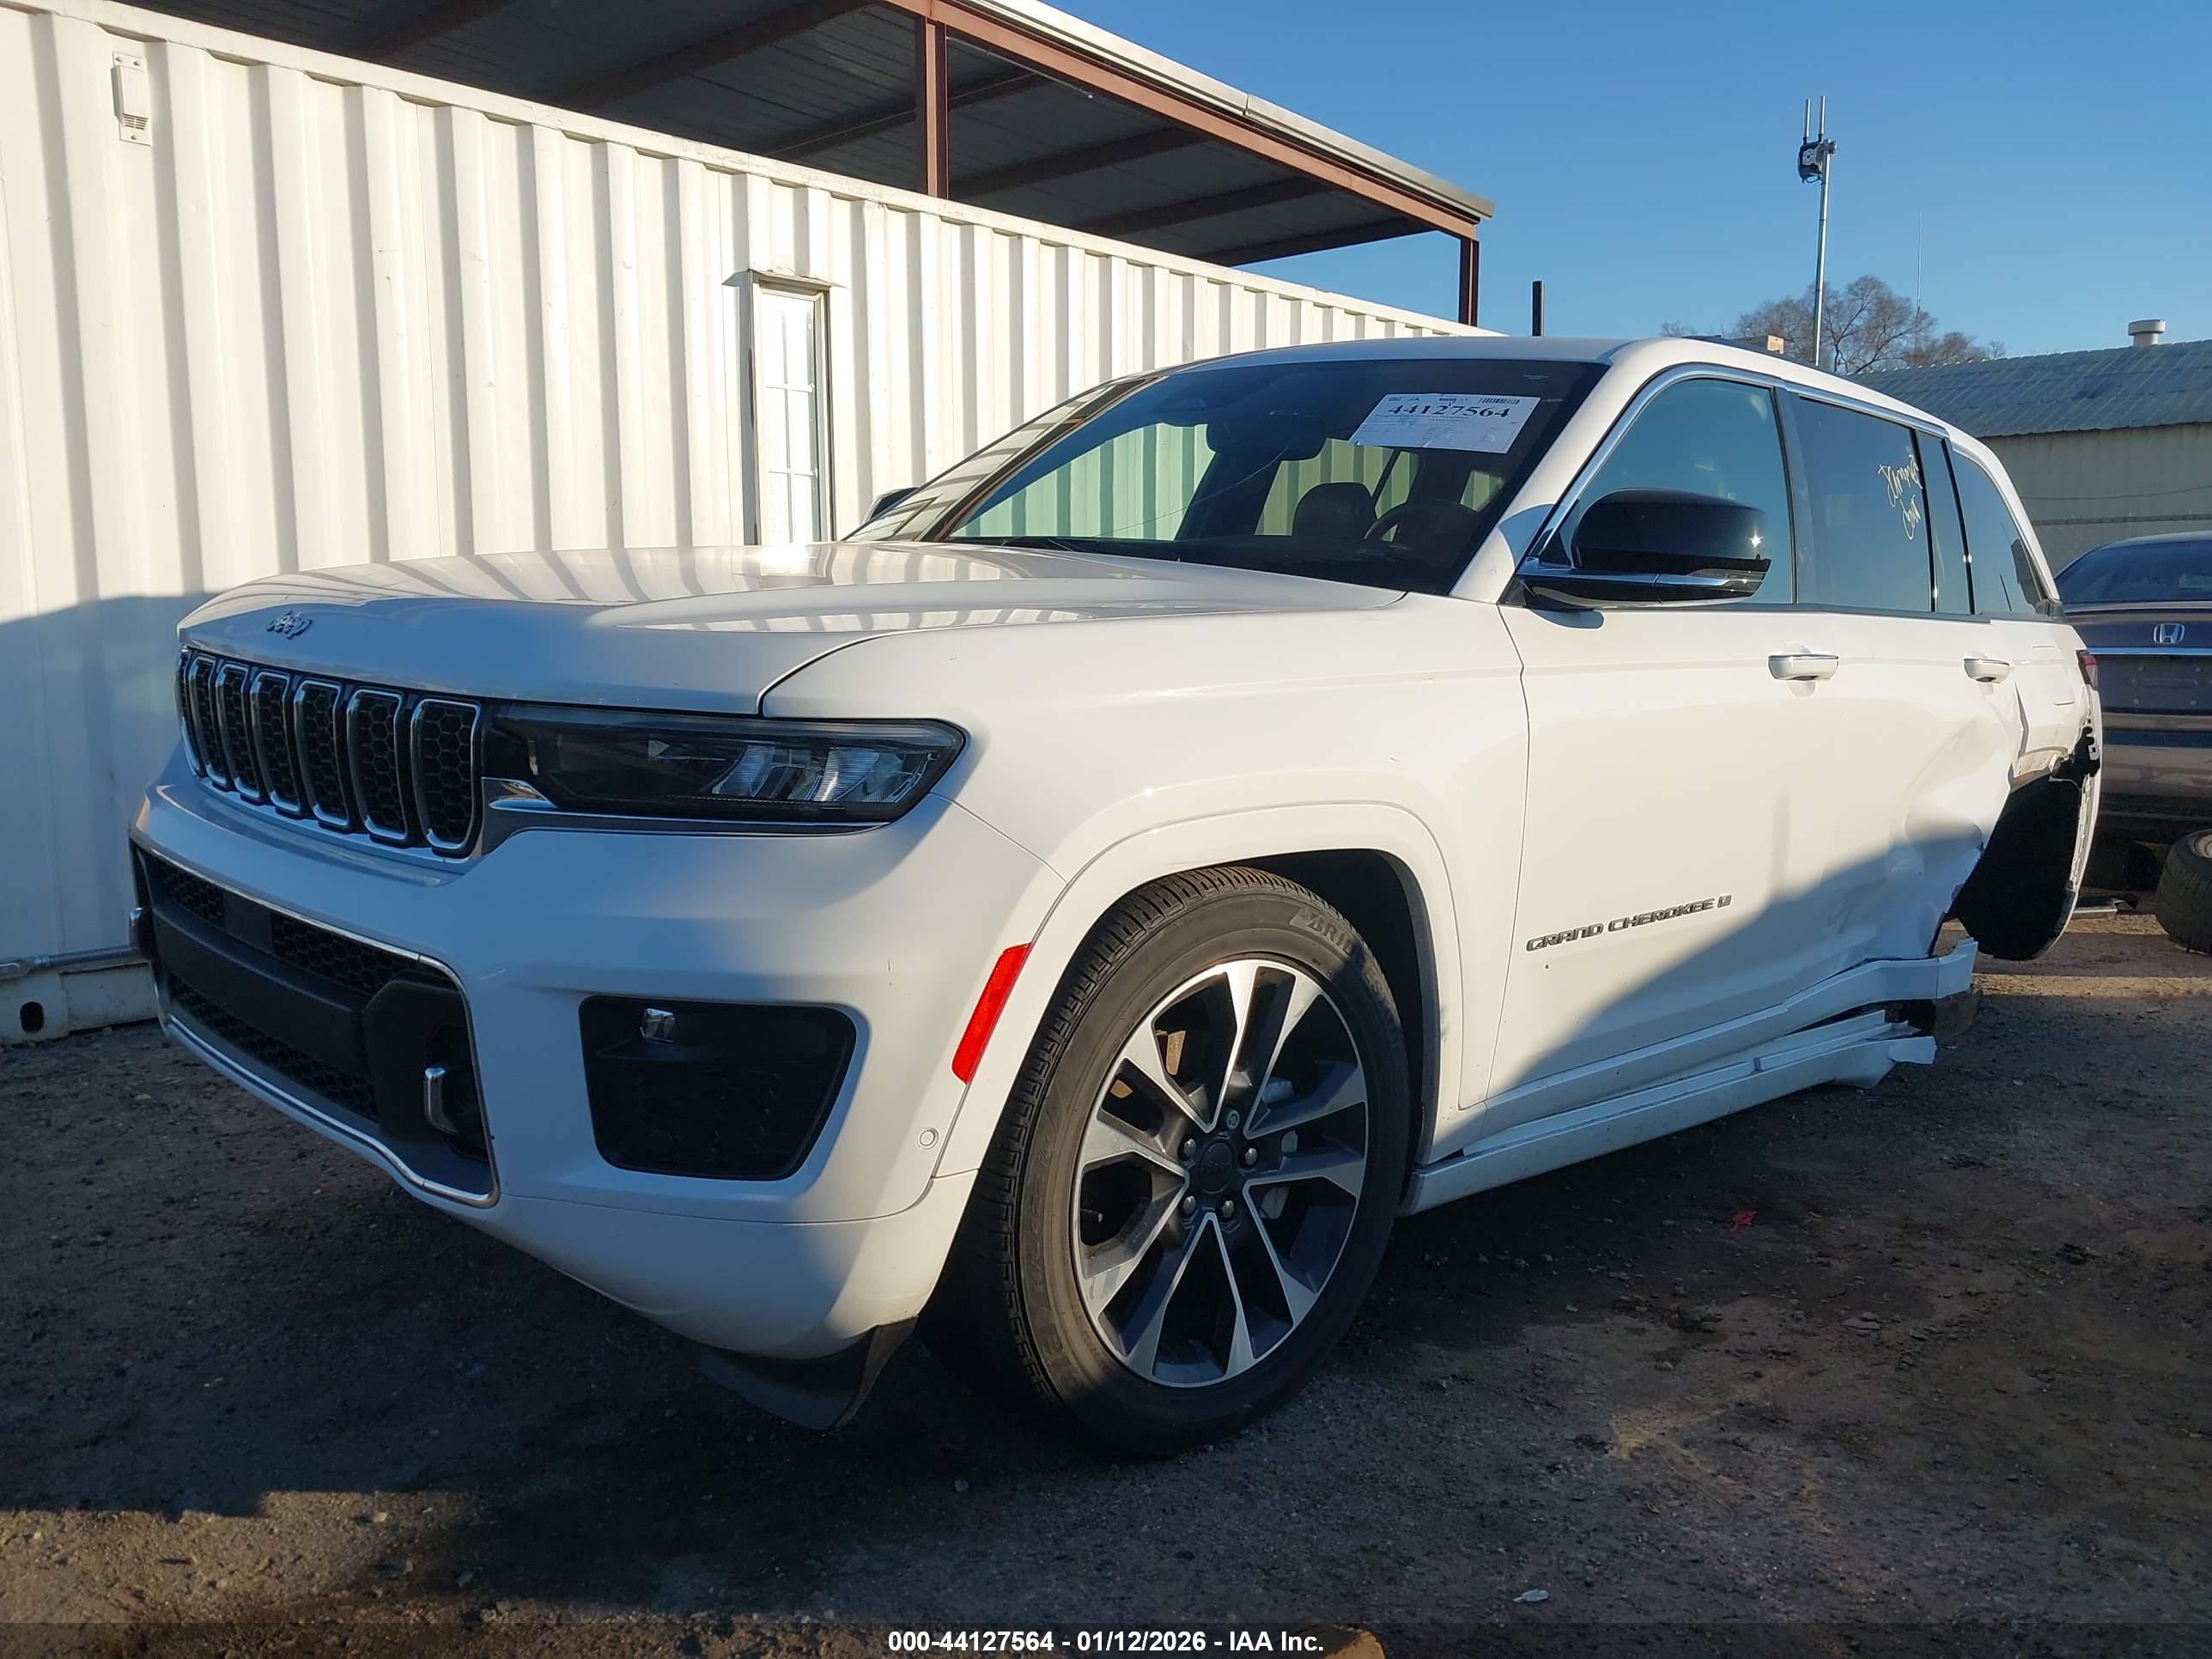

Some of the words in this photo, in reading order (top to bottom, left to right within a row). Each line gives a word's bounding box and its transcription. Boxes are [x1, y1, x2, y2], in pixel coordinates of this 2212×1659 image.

[1388, 404, 1511, 418] 44127564
[1526, 923, 1604, 952] GRAND
[1607, 897, 1716, 933] CHEROKEE
